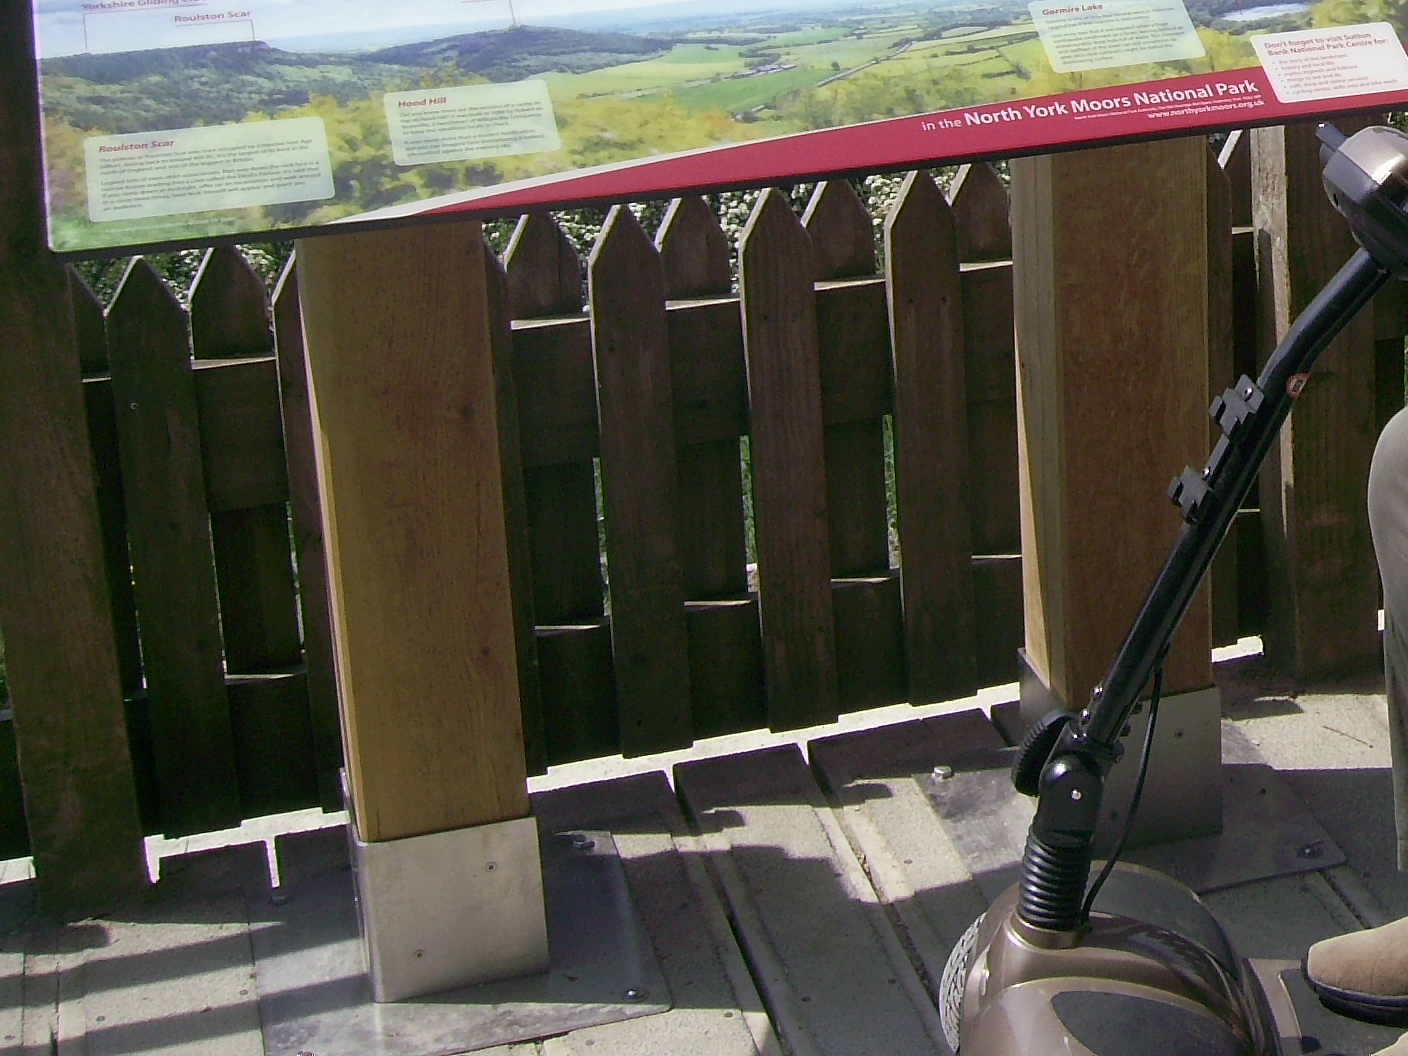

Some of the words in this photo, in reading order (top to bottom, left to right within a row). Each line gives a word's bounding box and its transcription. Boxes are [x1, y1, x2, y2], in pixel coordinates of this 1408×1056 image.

[1082, 3, 1103, 12] Lake
[174, 13, 225, 23] Roulston
[227, 10, 251, 19] Scar
[398, 99, 427, 109] Hood
[429, 96, 447, 105] Hill
[921, 121, 936, 131] in
[938, 118, 963, 129] the
[964, 107, 1022, 126] North
[1023, 102, 1069, 119] York
[1071, 95, 1131, 113] Moors
[1134, 84, 1214, 106] National
[1215, 80, 1258, 96] Park
[1147, 101, 1265, 120] www.northyorkmoors.org.uk
[99, 142, 149, 153] Roulston
[151, 139, 176, 149] Scar
